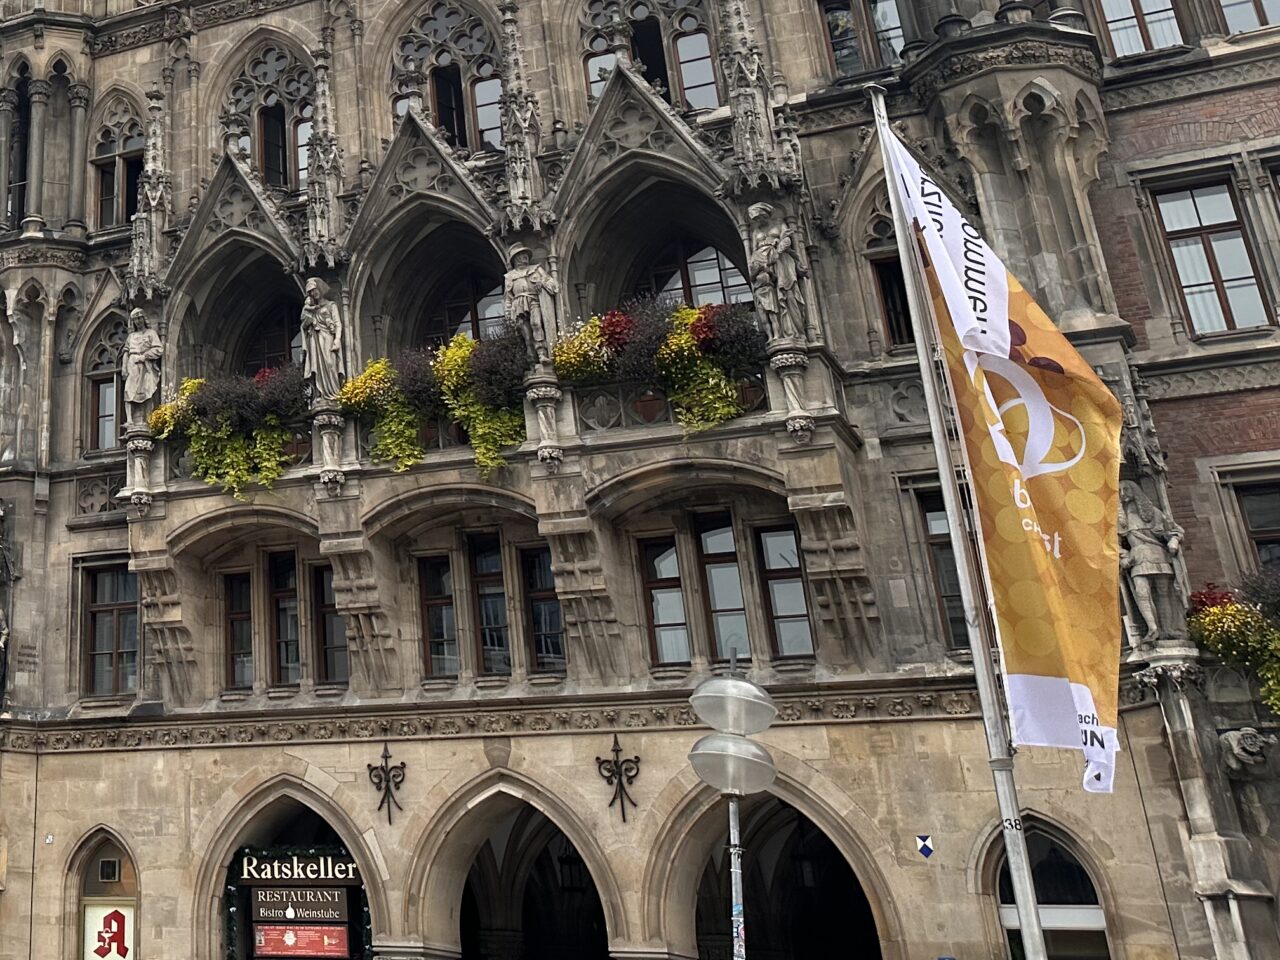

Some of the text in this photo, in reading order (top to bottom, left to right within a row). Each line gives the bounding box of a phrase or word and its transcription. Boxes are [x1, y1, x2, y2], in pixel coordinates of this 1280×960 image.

[241, 855, 358, 880] Ratskeller
[257, 890, 341, 902] RESTAURANT
[259, 907, 340, 919] Bistro Weinstube
